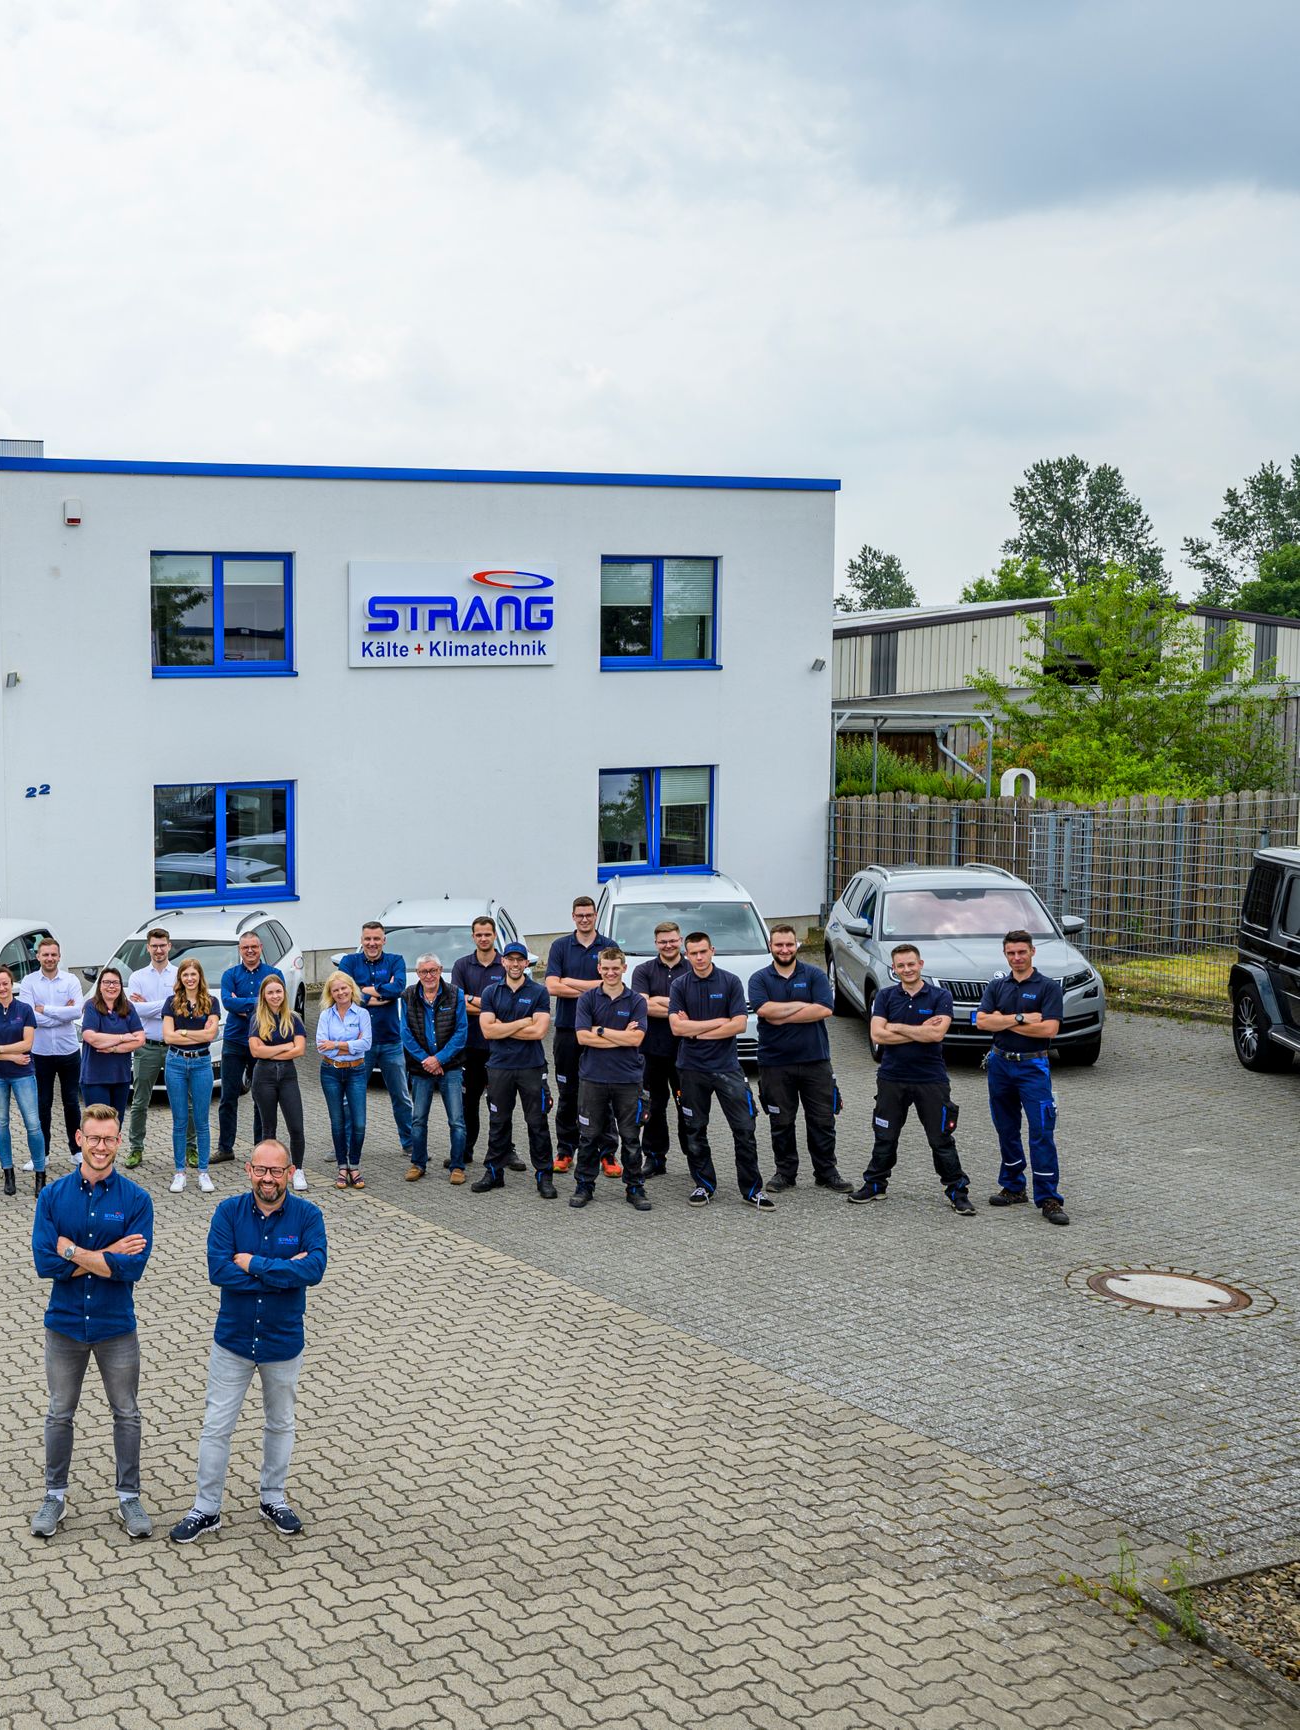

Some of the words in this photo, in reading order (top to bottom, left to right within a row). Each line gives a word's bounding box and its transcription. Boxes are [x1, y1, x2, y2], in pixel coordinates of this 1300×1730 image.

[367, 595, 554, 632] STRANG
[361, 640, 409, 658] Kälte
[414, 643, 424, 655] +
[429, 640, 547, 657] Klimatechnik
[25, 784, 51, 798] 22
